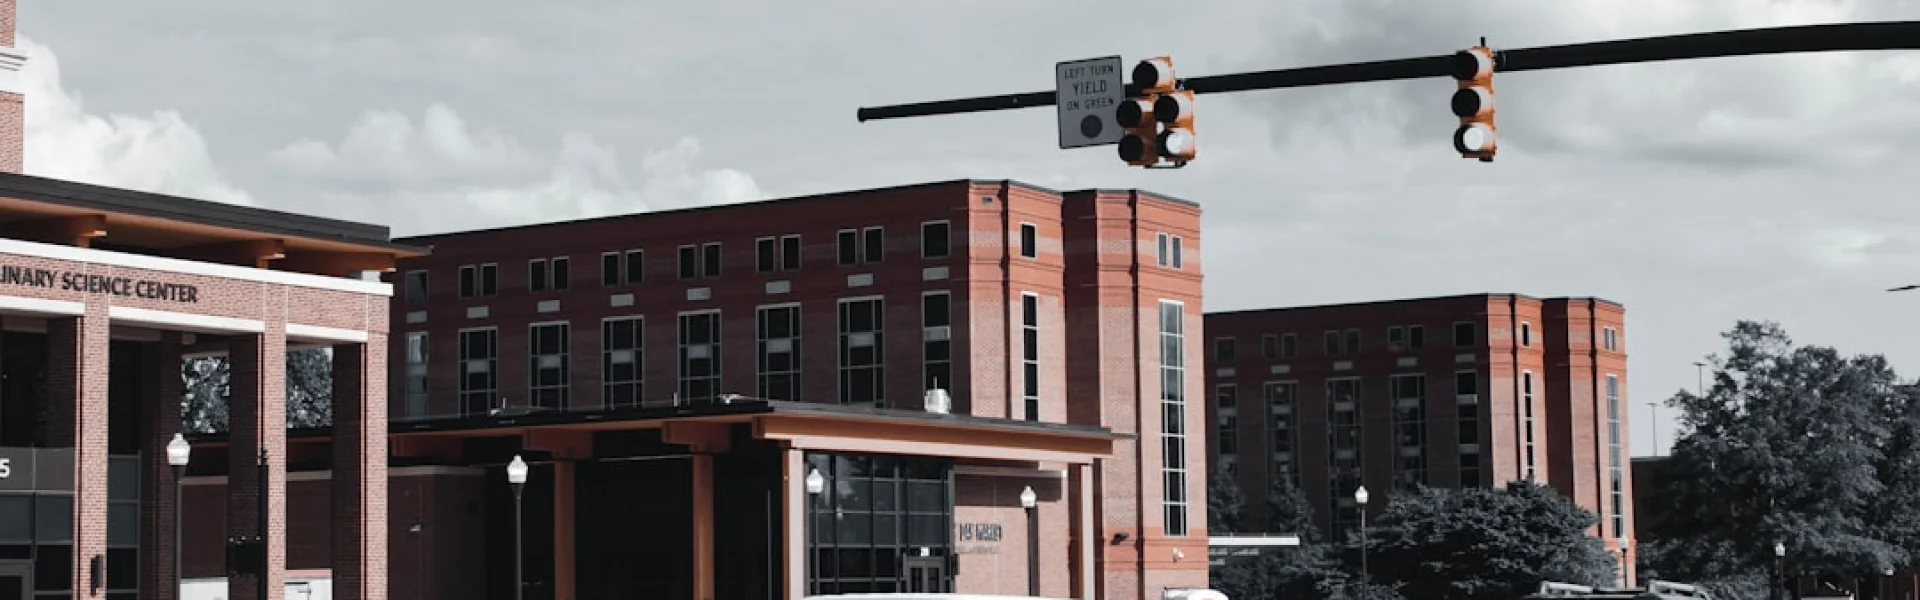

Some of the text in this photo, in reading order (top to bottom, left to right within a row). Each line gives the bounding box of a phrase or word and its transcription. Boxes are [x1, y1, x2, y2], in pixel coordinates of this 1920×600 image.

[1064, 65, 1113, 78] LEFT TURN
[1072, 80, 1106, 96] YIELD
[1067, 98, 1114, 110] ON GREEN
[62, 272, 131, 296] SCIENCE
[135, 280, 197, 302] CENTER
